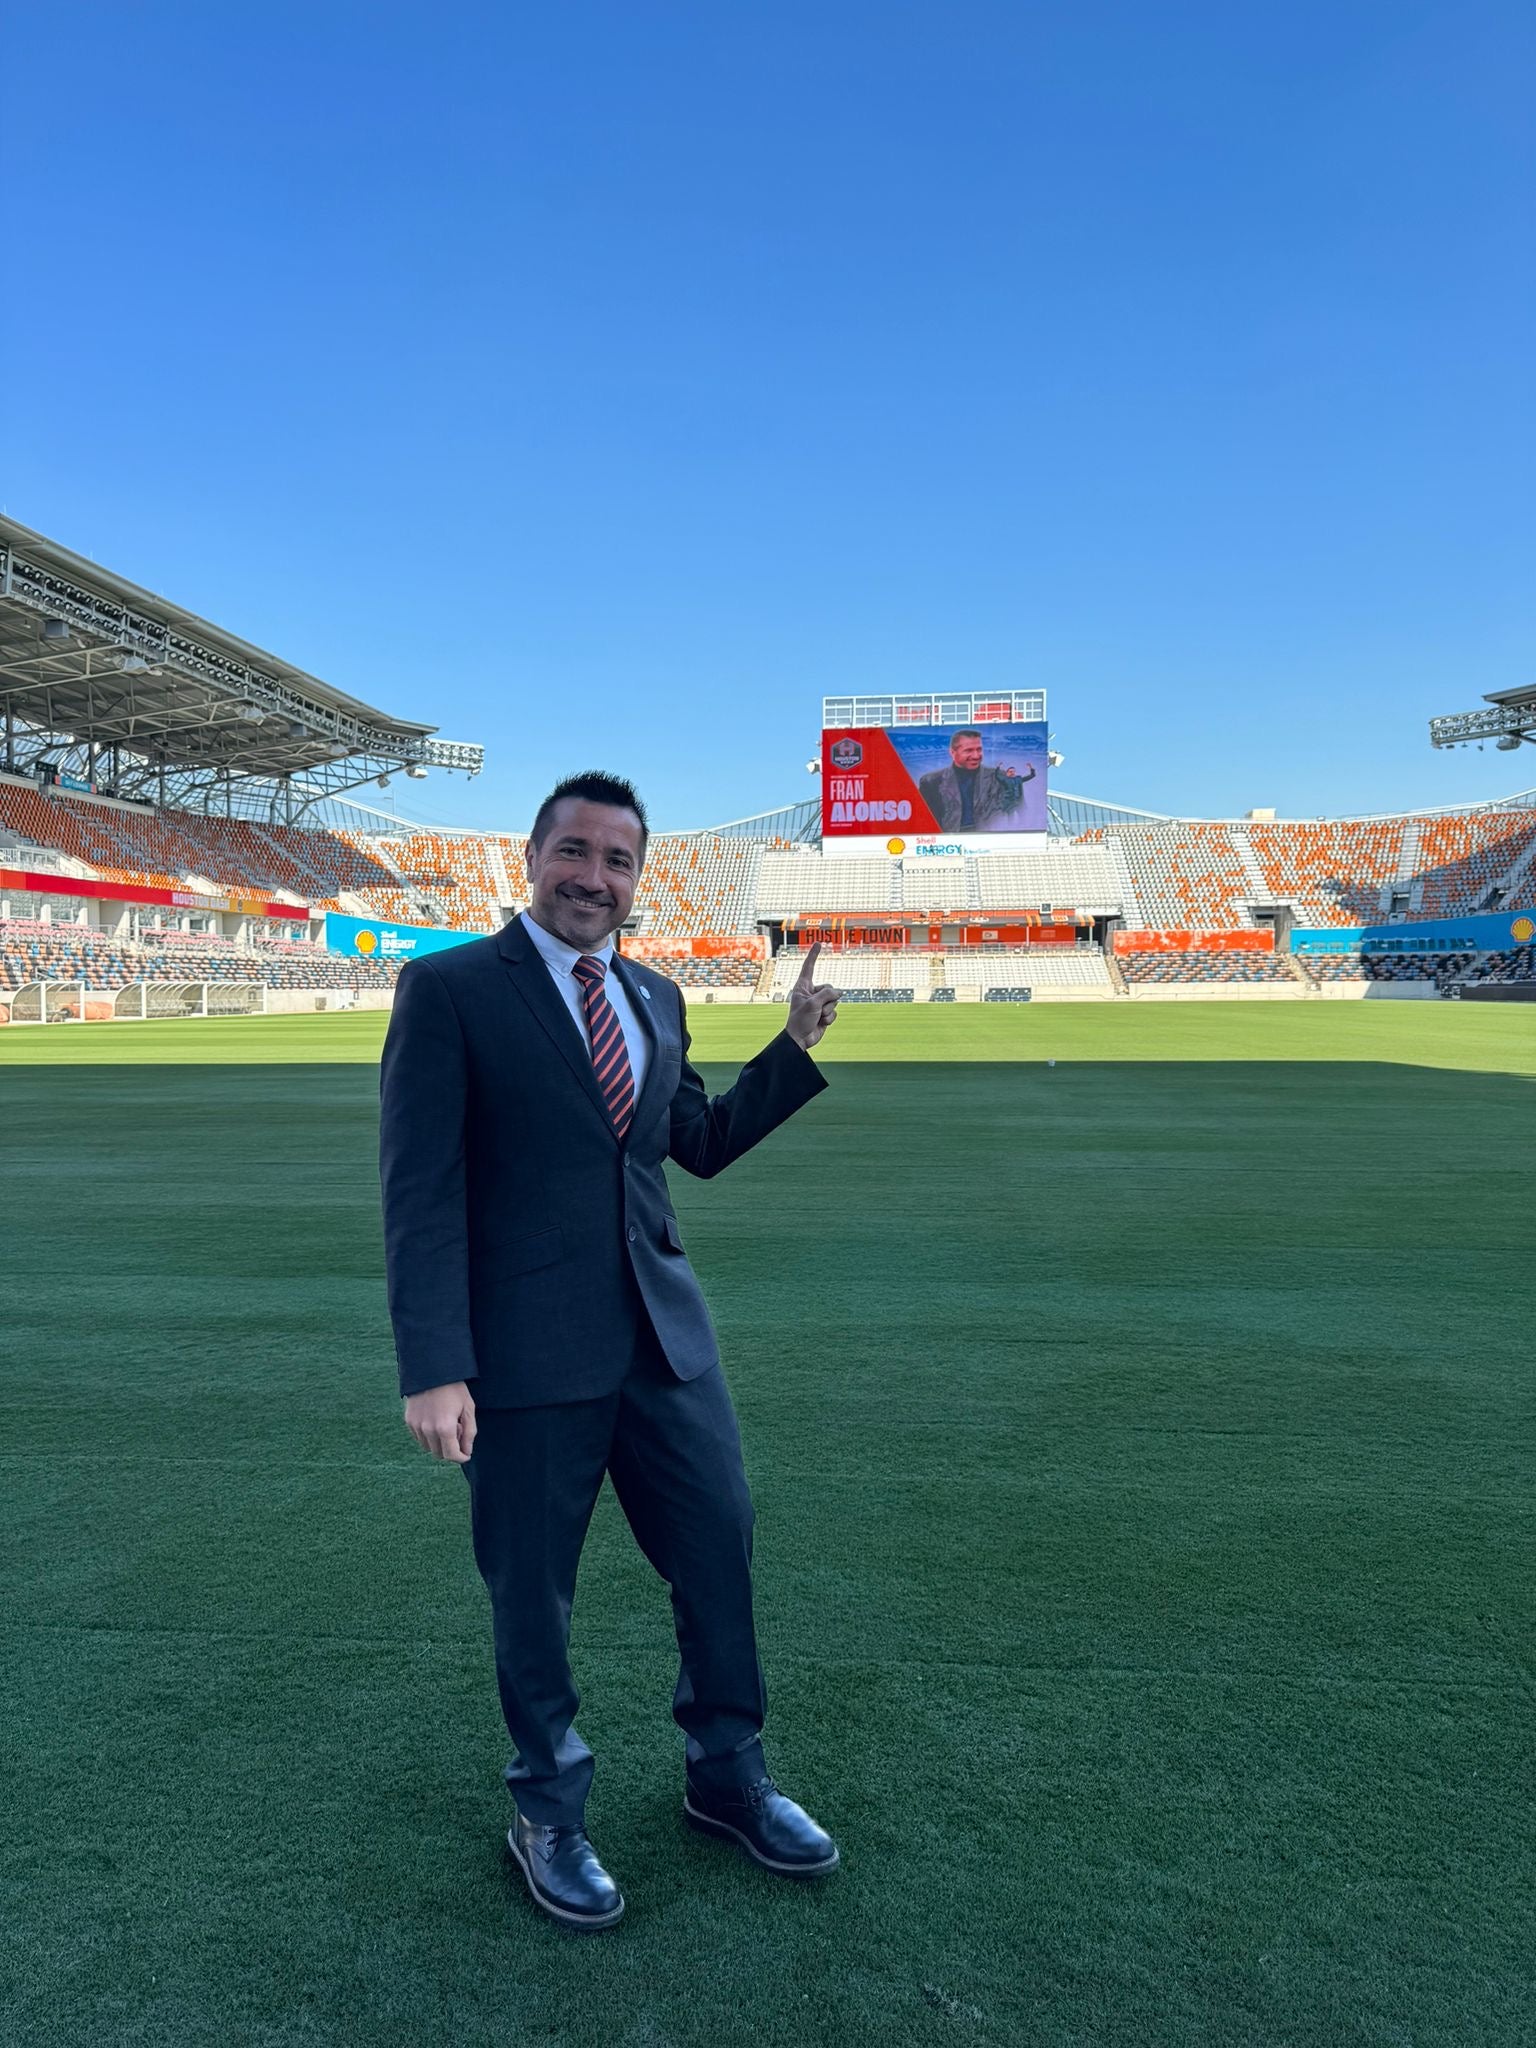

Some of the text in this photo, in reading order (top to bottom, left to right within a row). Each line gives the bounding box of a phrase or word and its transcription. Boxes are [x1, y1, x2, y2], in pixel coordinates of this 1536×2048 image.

[830, 779, 864, 800] FRAN
[830, 800, 912, 822] ALONSO
[806, 927, 904, 944] HUSTE TOWN
